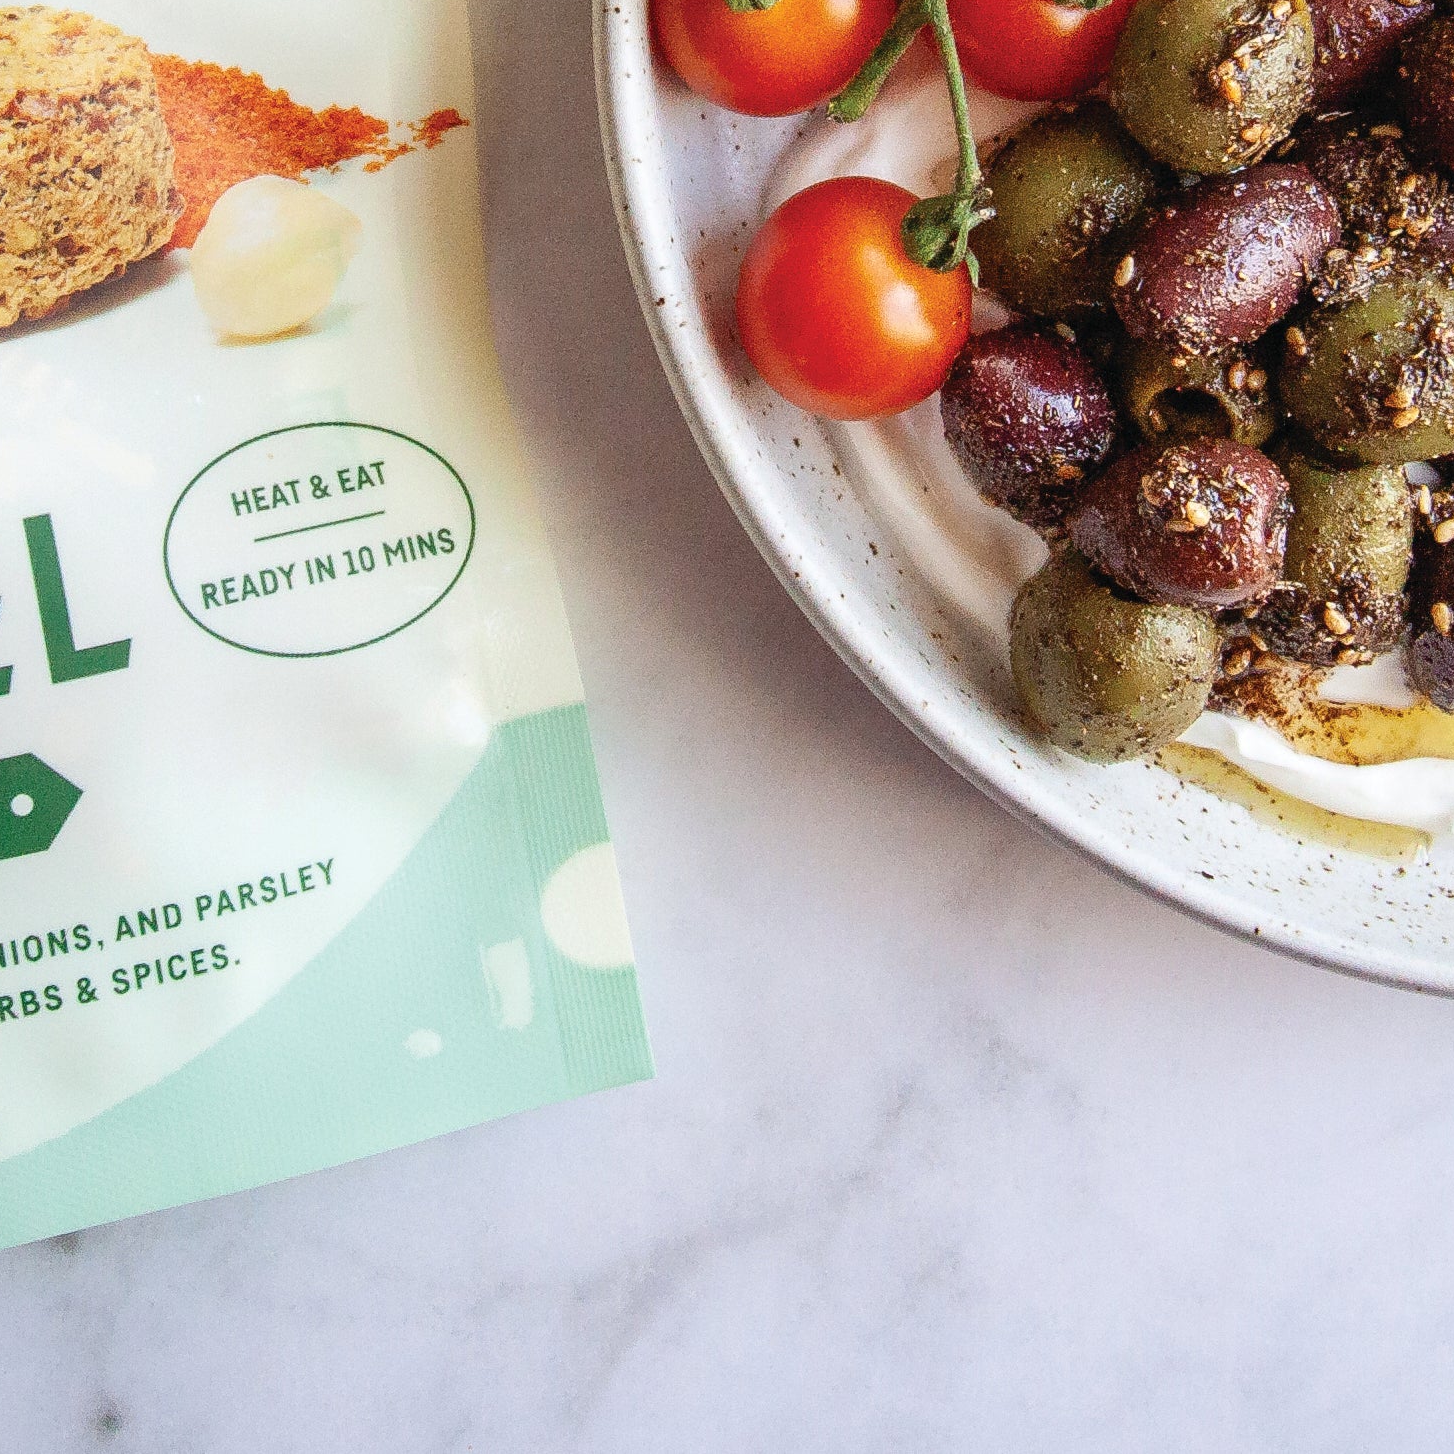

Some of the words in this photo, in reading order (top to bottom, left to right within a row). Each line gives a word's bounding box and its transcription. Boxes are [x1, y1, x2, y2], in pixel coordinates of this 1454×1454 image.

[230, 480, 301, 517] HEAT
[309, 474, 333, 500] &
[336, 461, 386, 494] EAT
[201, 562, 296, 610] READY
[304, 553, 336, 585] IN
[342, 545, 376, 577] 10
[382, 527, 456, 567] MINS
[115, 901, 183, 943] AND
[195, 857, 337, 922] PARSLEY
[76, 976, 100, 1005] &
[112, 943, 242, 996] SPICES.
